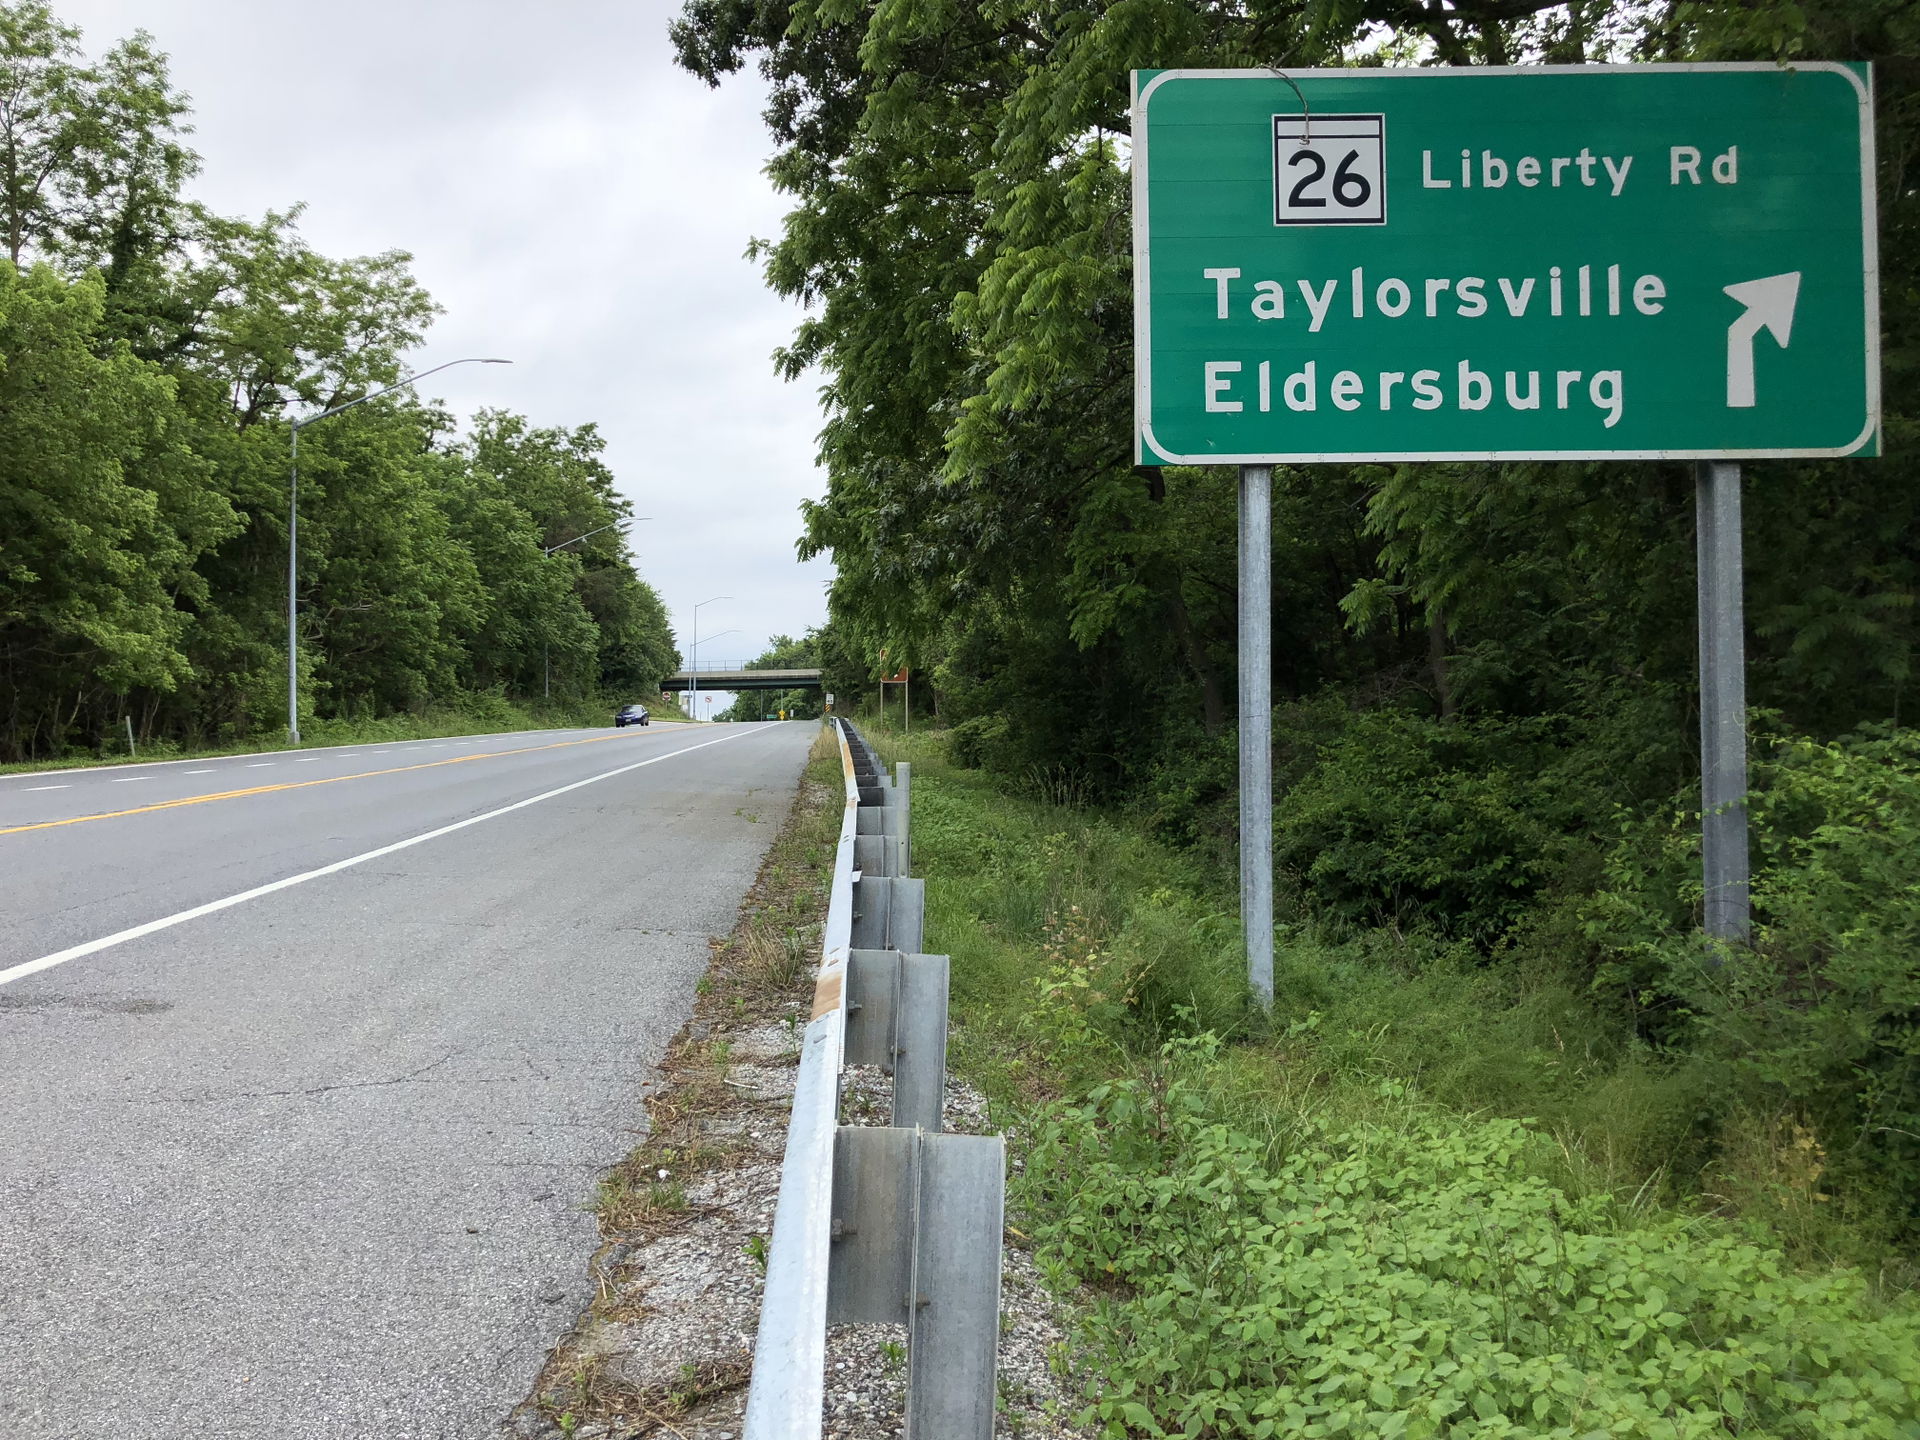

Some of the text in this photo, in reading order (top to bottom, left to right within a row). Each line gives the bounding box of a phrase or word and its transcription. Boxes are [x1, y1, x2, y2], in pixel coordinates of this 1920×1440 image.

[1288, 149, 1371, 208] 26
[1422, 145, 1738, 196] Liberty Rd
[1203, 264, 1667, 333] Taylorsville
[1204, 359, 1624, 429] Eldersburg
